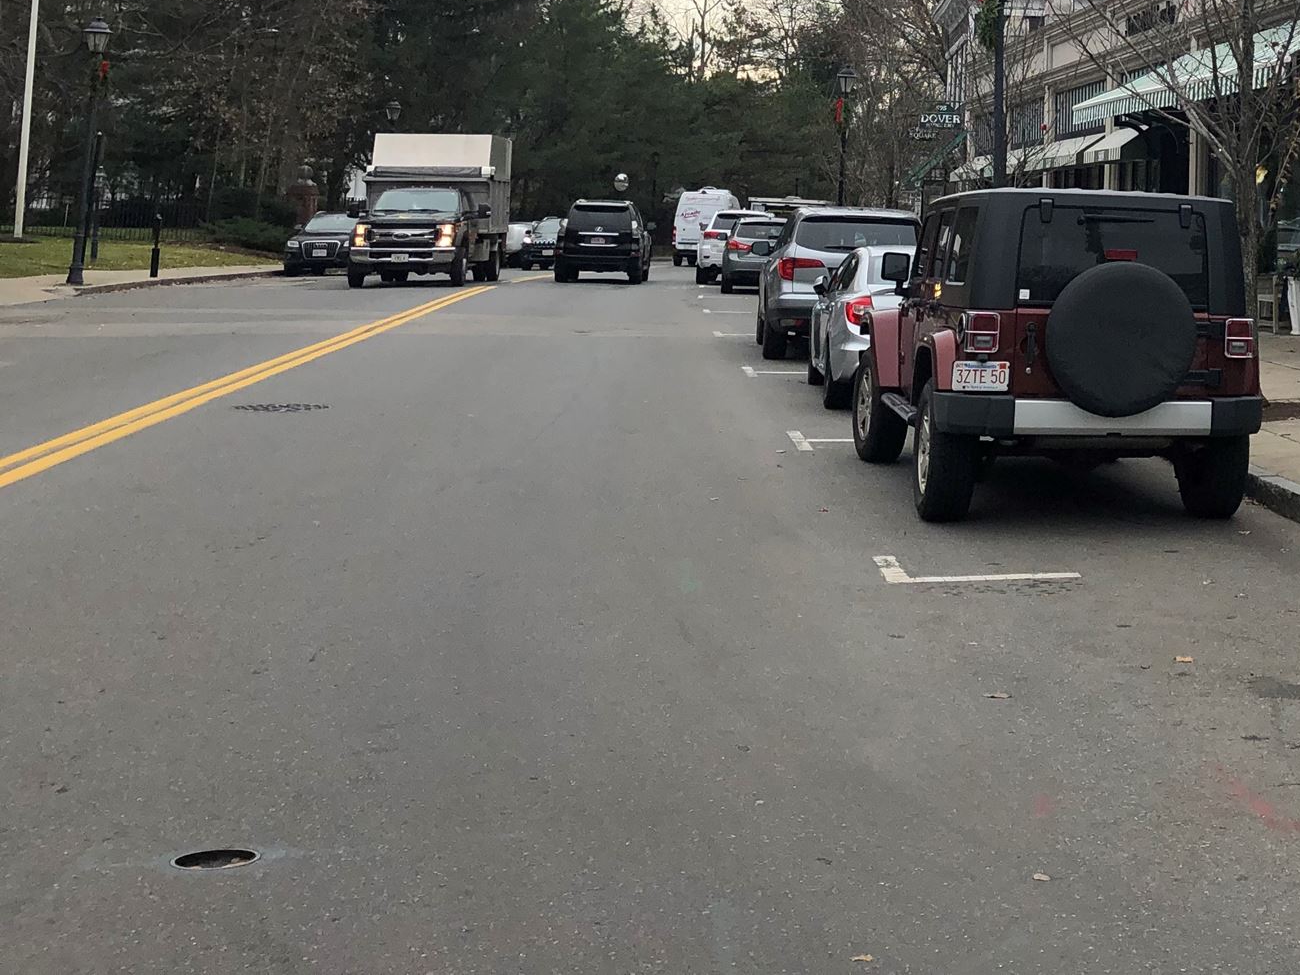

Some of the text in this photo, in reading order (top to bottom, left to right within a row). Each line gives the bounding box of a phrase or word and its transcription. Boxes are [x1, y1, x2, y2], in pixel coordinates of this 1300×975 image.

[920, 114, 961, 124] DOVER
[956, 369, 1007, 384] 3ZTE 50
